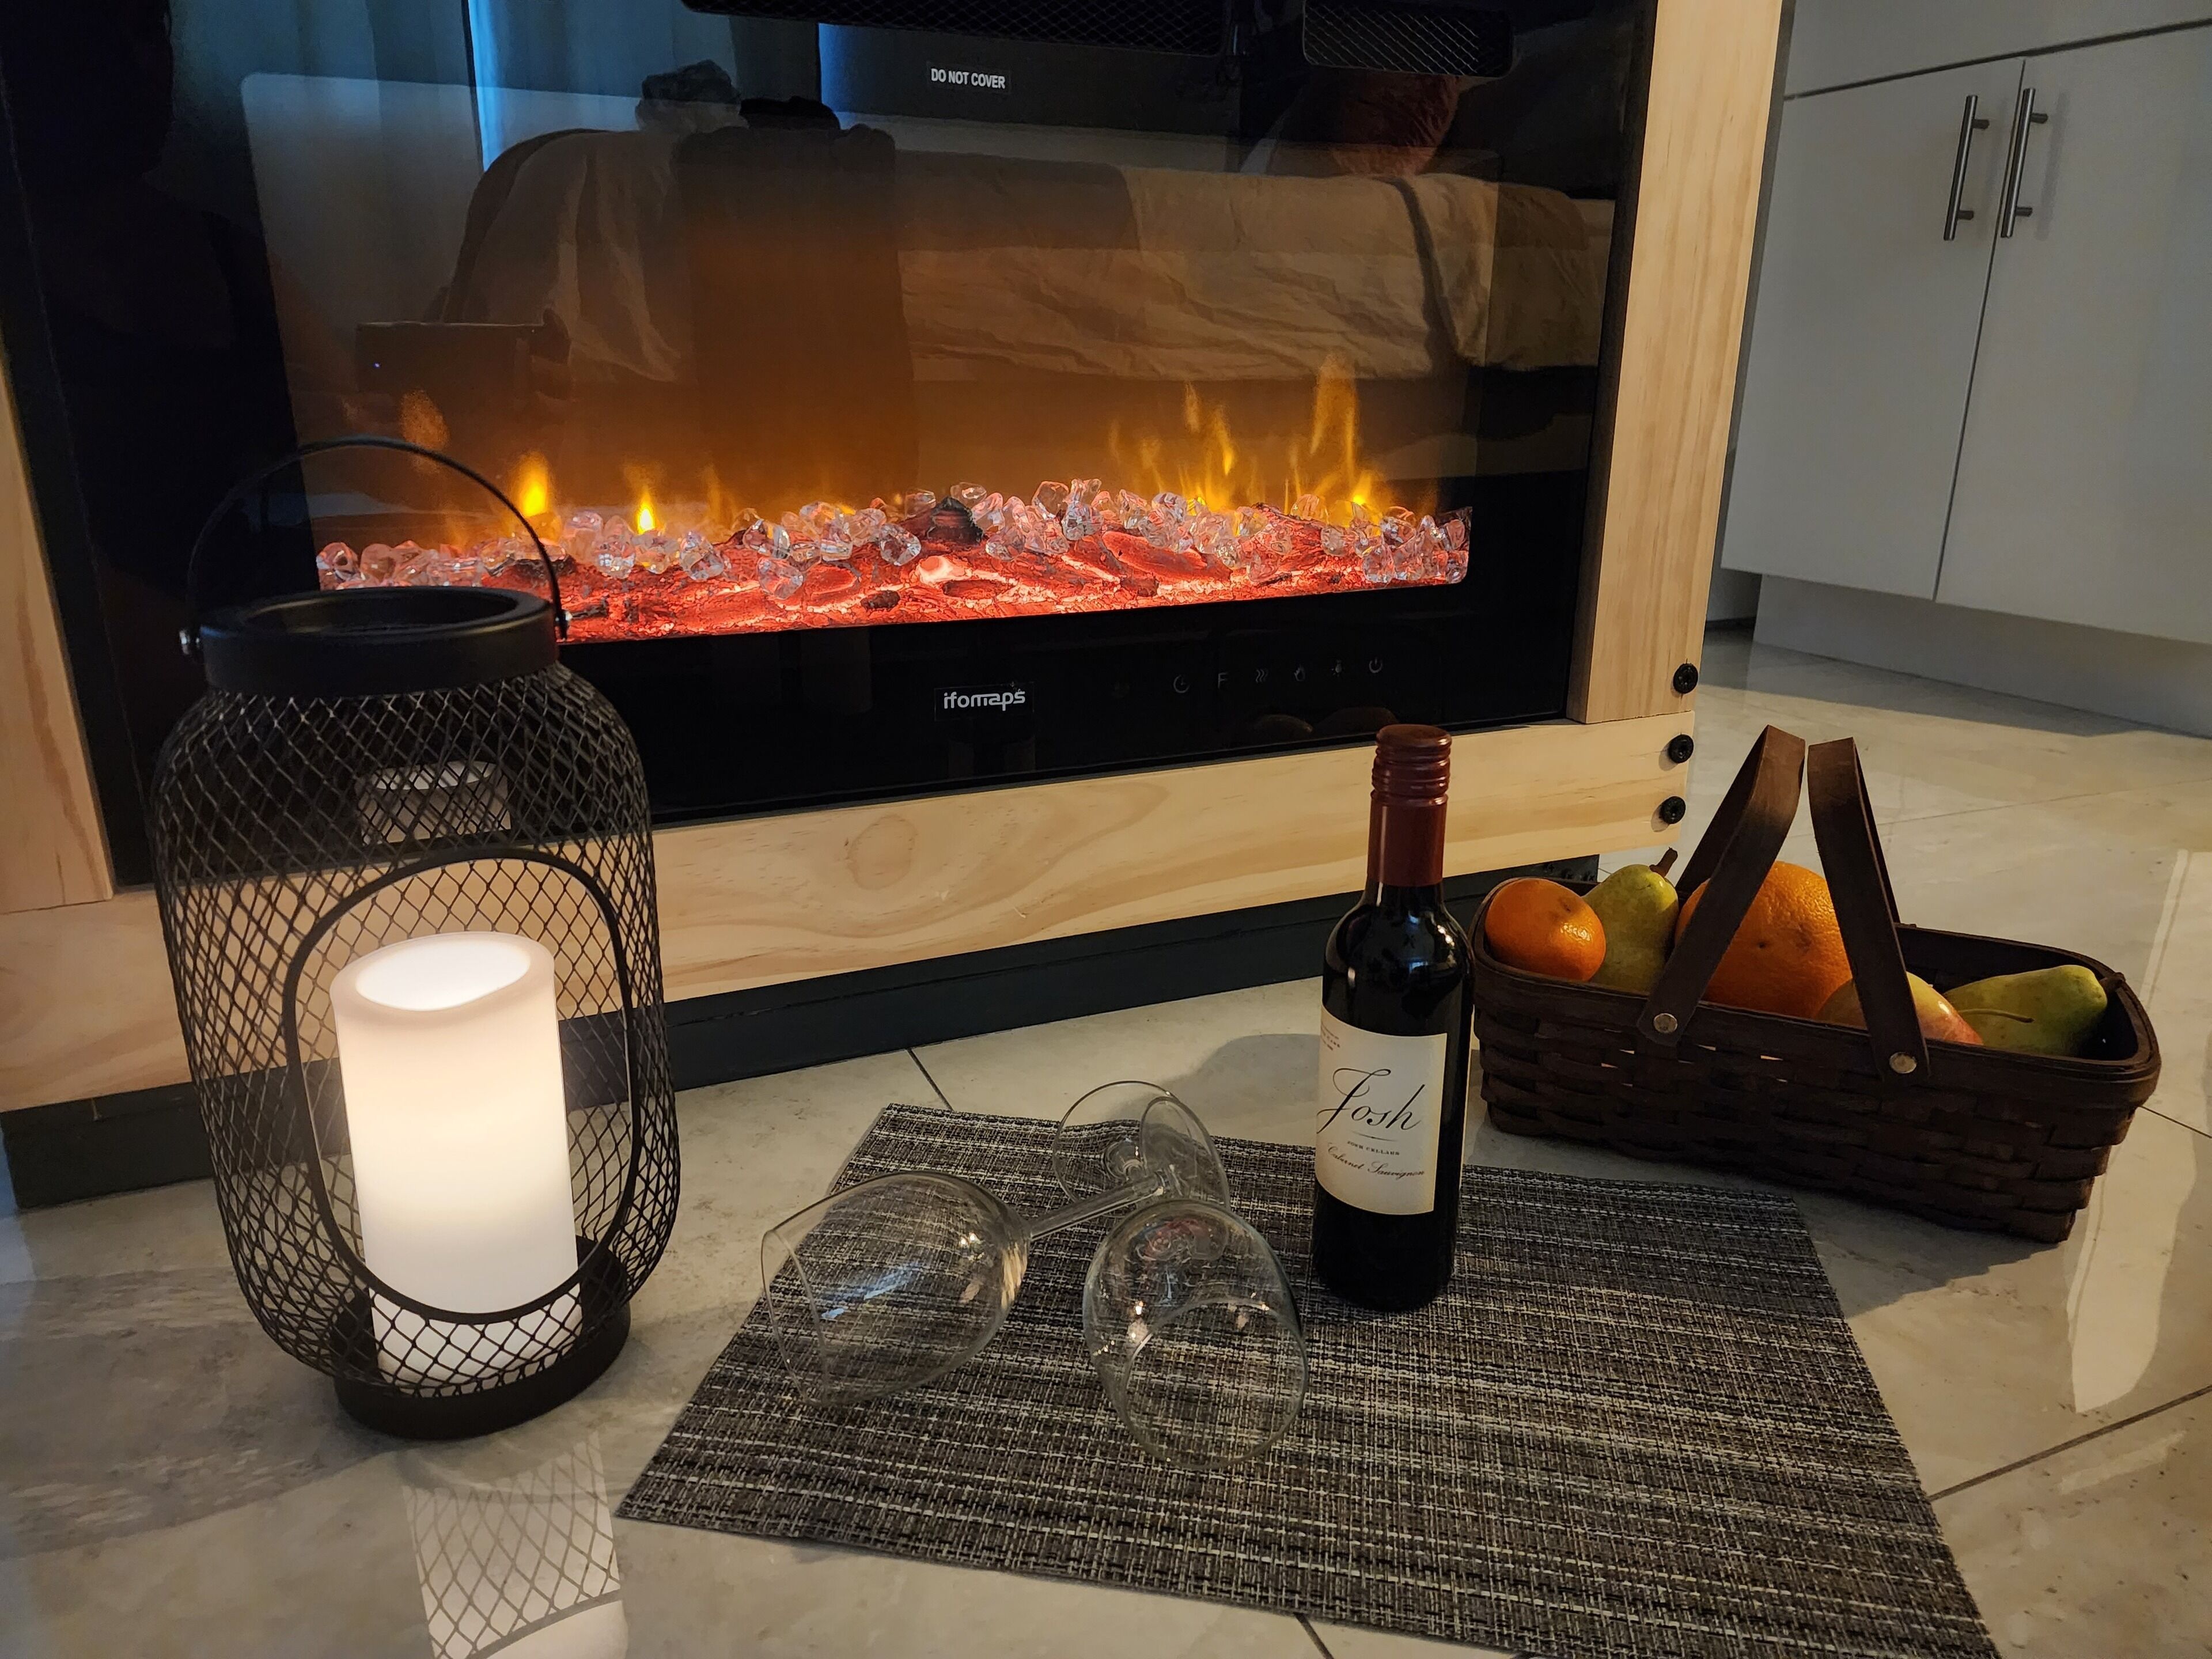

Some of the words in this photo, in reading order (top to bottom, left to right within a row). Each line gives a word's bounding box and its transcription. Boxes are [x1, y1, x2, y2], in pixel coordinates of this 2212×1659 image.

[931, 68, 946, 82] DO
[948, 70, 969, 85] NOT
[971, 73, 1006, 89] COVER
[1217, 672, 1228, 689] F
[944, 691, 1025, 711] ifomaps
[1316, 1067, 1425, 1134] Josh
[1327, 1142, 1365, 1170] Cabernet
[1367, 1160, 1425, 1180] Sauvignon
